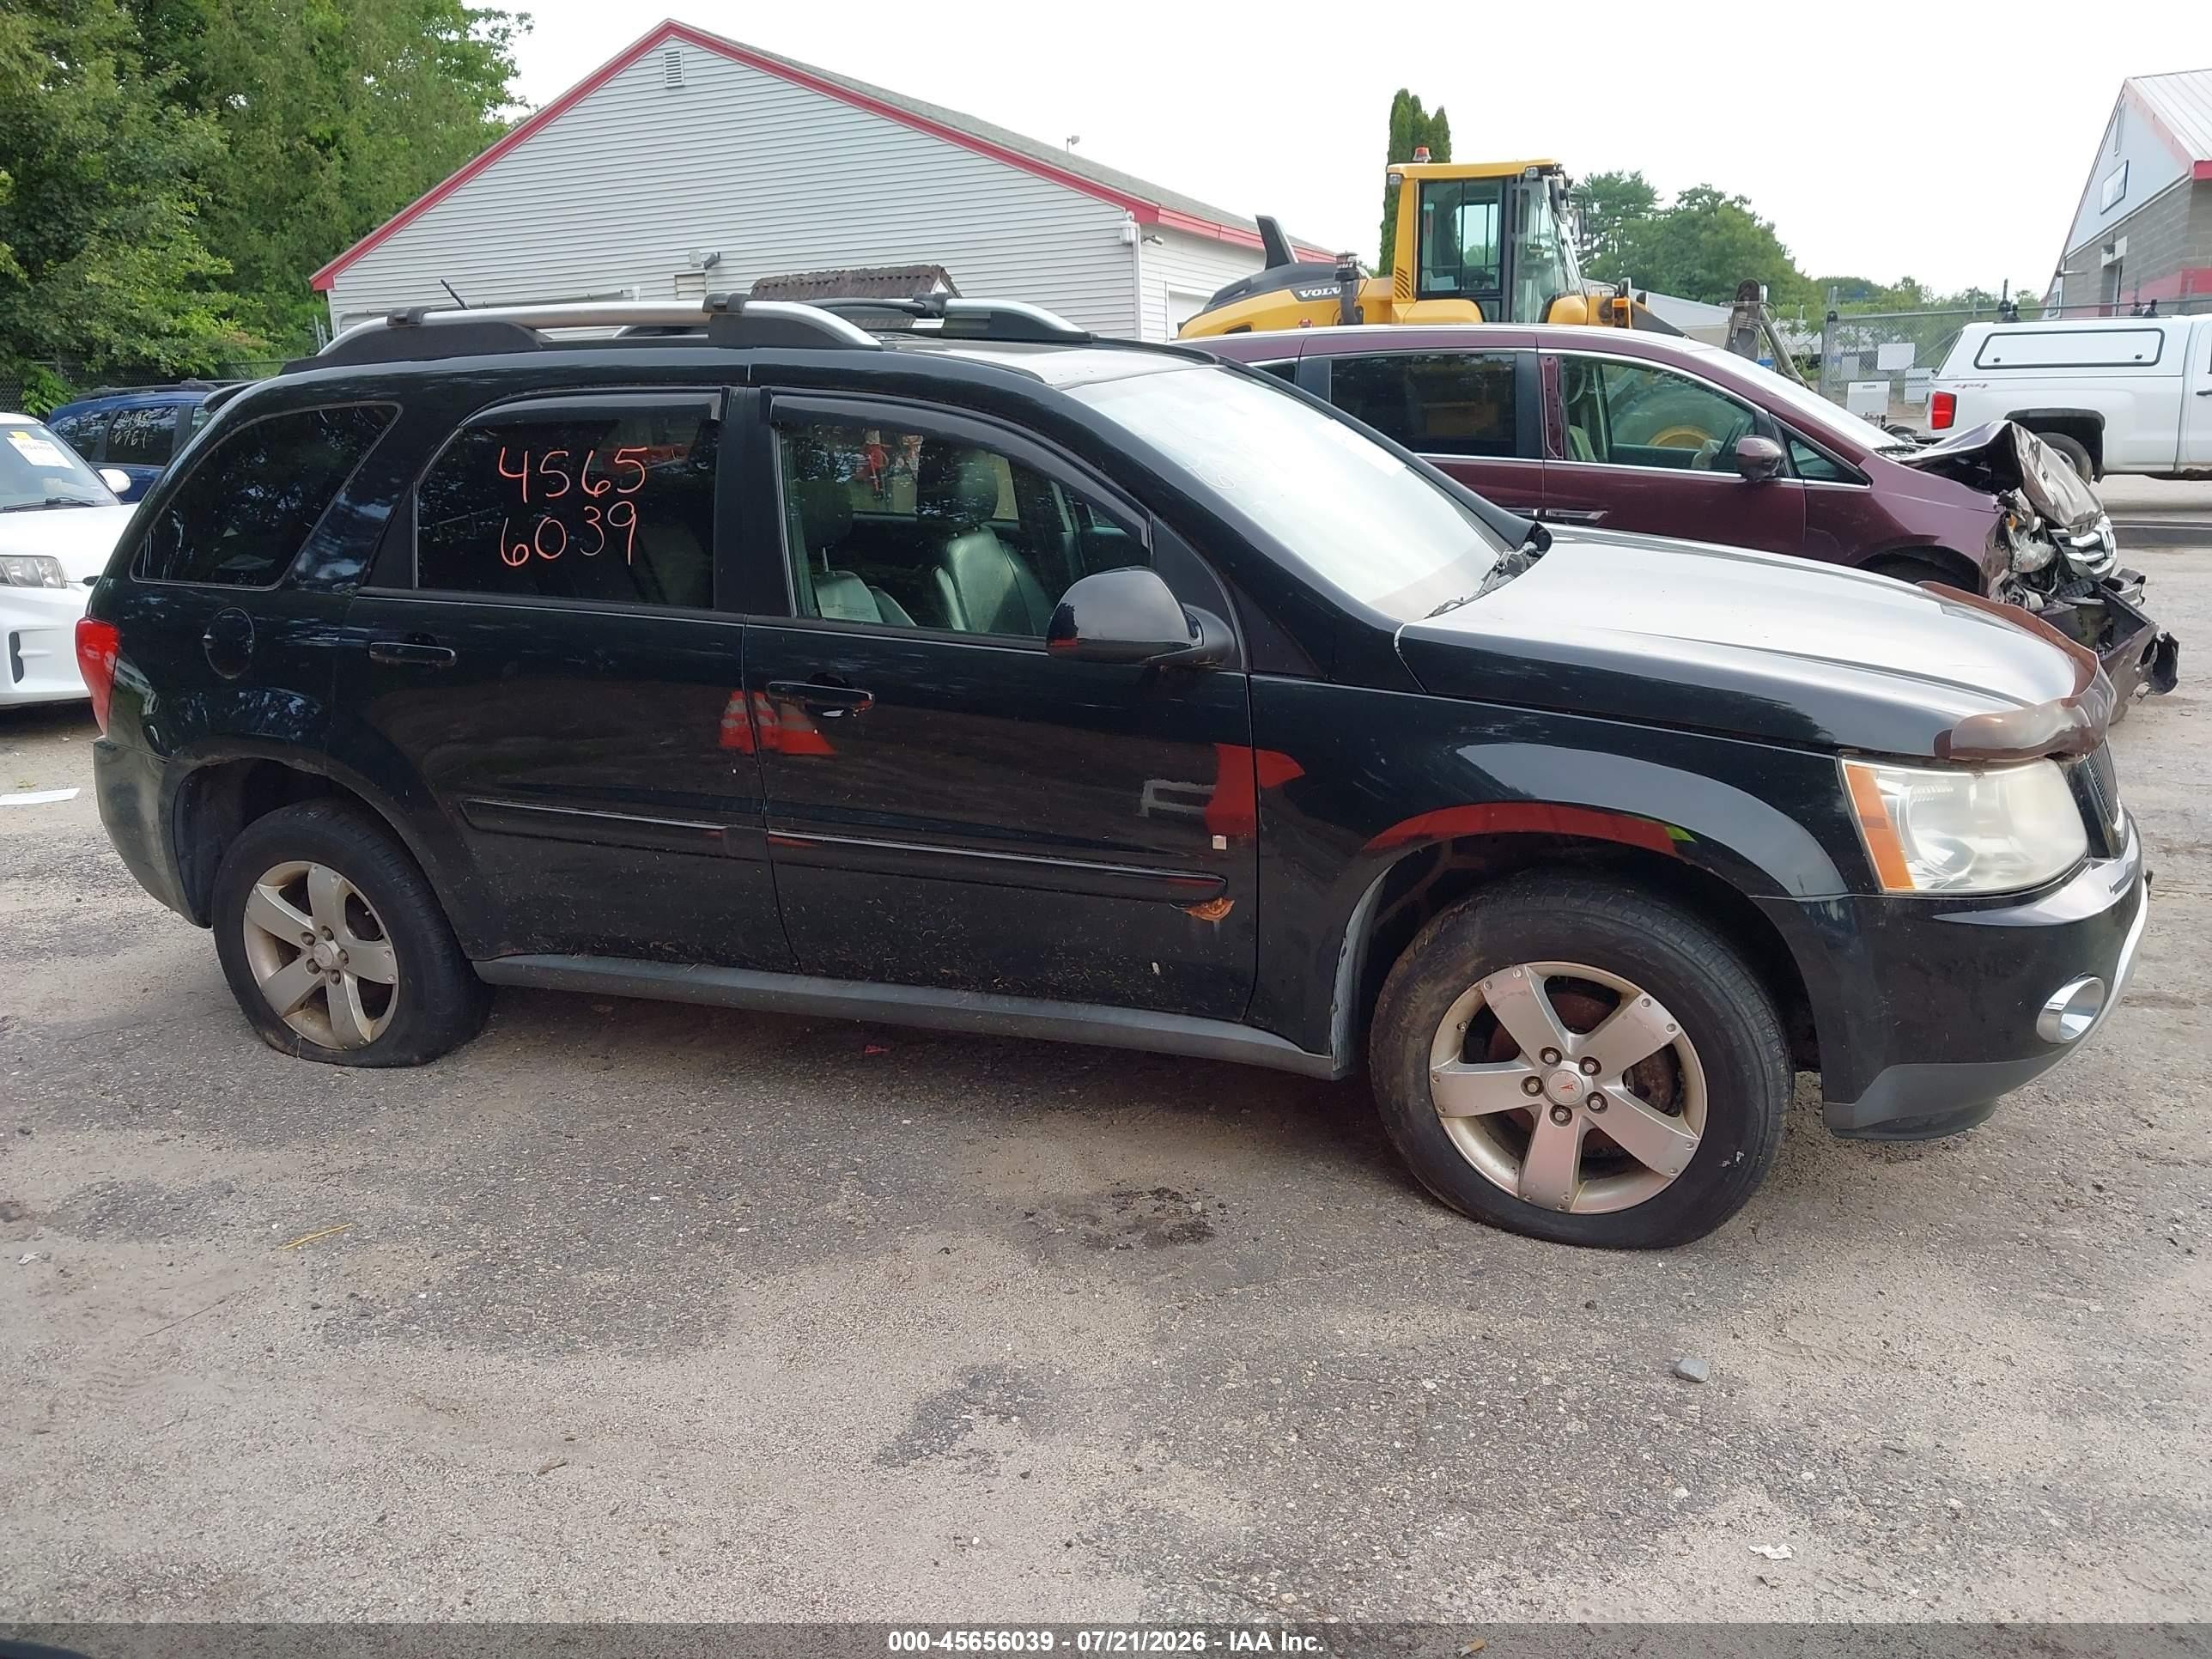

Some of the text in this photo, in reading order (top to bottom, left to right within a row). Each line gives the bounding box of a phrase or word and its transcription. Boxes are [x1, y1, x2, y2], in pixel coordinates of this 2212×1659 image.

[1298, 286, 1342, 298] VOLV
[498, 447, 647, 503] 4565
[501, 501, 636, 567] 6039
